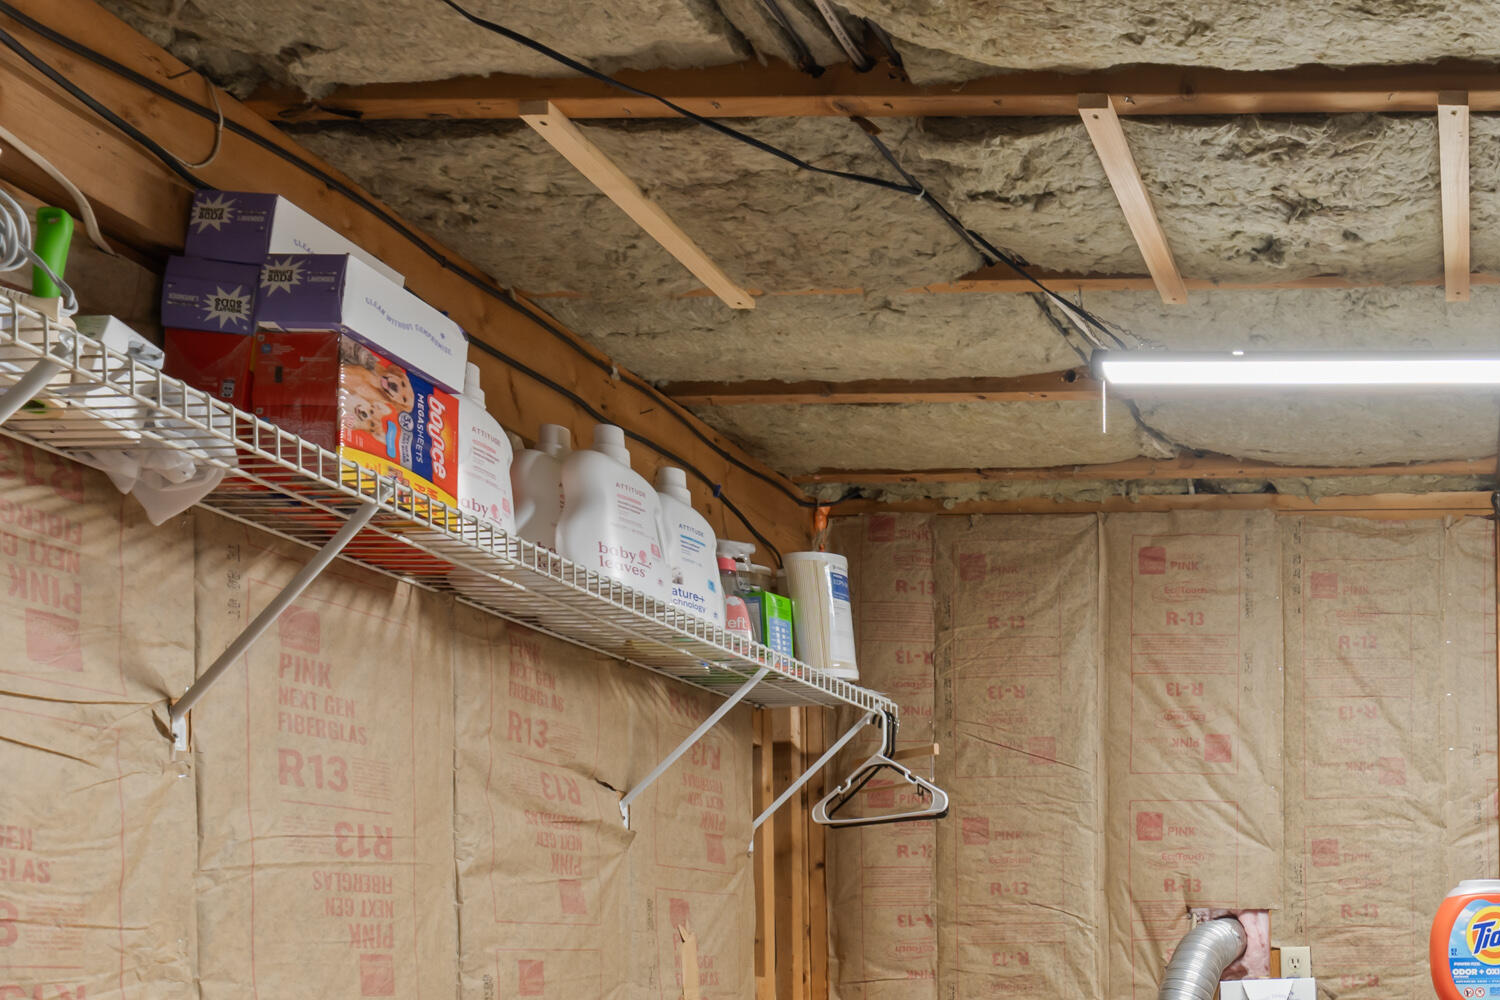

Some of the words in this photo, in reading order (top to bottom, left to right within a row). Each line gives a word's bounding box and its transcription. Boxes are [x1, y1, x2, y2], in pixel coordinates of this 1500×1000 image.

[416, 393, 426, 464] MEGASHEETS
[428, 394, 447, 480] bounce
[471, 426, 501, 445] ATTITUDE
[615, 481, 646, 499] ATTITUDE
[460, 498, 489, 516] aby
[678, 523, 705, 538] ATTITUDE
[598, 541, 637, 563] baby
[600, 554, 646, 578] leaves
[1169, 560, 1200, 571] PINK
[8, 562, 83, 616] PINK
[672, 586, 705, 603] ature+
[895, 579, 935, 595] R-13
[1164, 585, 1209, 595] EcoTouch
[1342, 584, 1370, 596] PINK
[672, 596, 706, 614] chnology
[727, 617, 747, 629] eft
[987, 615, 1025, 630] R-13
[1165, 611, 1205, 626] R-13
[509, 636, 539, 658] PINK
[1339, 635, 1377, 649] R-13
[895, 650, 934, 665] R-13
[279, 652, 332, 690] PINK
[509, 681, 564, 713] FIBERGLAS
[987, 684, 1025, 700] R-13
[1165, 682, 1204, 697] R-13
[279, 684, 317, 711] NEXT
[324, 694, 355, 719] GEN
[1338, 705, 1377, 720] R-13
[278, 711, 367, 746] FIBERGLAS
[508, 710, 549, 749] R13
[1172, 737, 1200, 749] PINK
[278, 747, 349, 793] R13
[539, 771, 582, 806] R13
[994, 831, 1024, 841] PINK
[1167, 826, 1196, 837] PINK
[334, 821, 393, 860] R13
[551, 853, 583, 876] PINK
[1162, 852, 1205, 861] EcoTouch
[312, 871, 393, 894] FIBERGLAS
[989, 882, 1029, 896] R-13
[1163, 878, 1203, 893] R-13
[324, 897, 355, 918] GEN
[361, 898, 394, 918] NEXT
[1340, 904, 1379, 919] R-13
[348, 923, 394, 950] PINK
[992, 951, 1030, 967] R-13
[1452, 968, 1478, 976] ODOR
[1485, 968, 1500, 976] OXI
